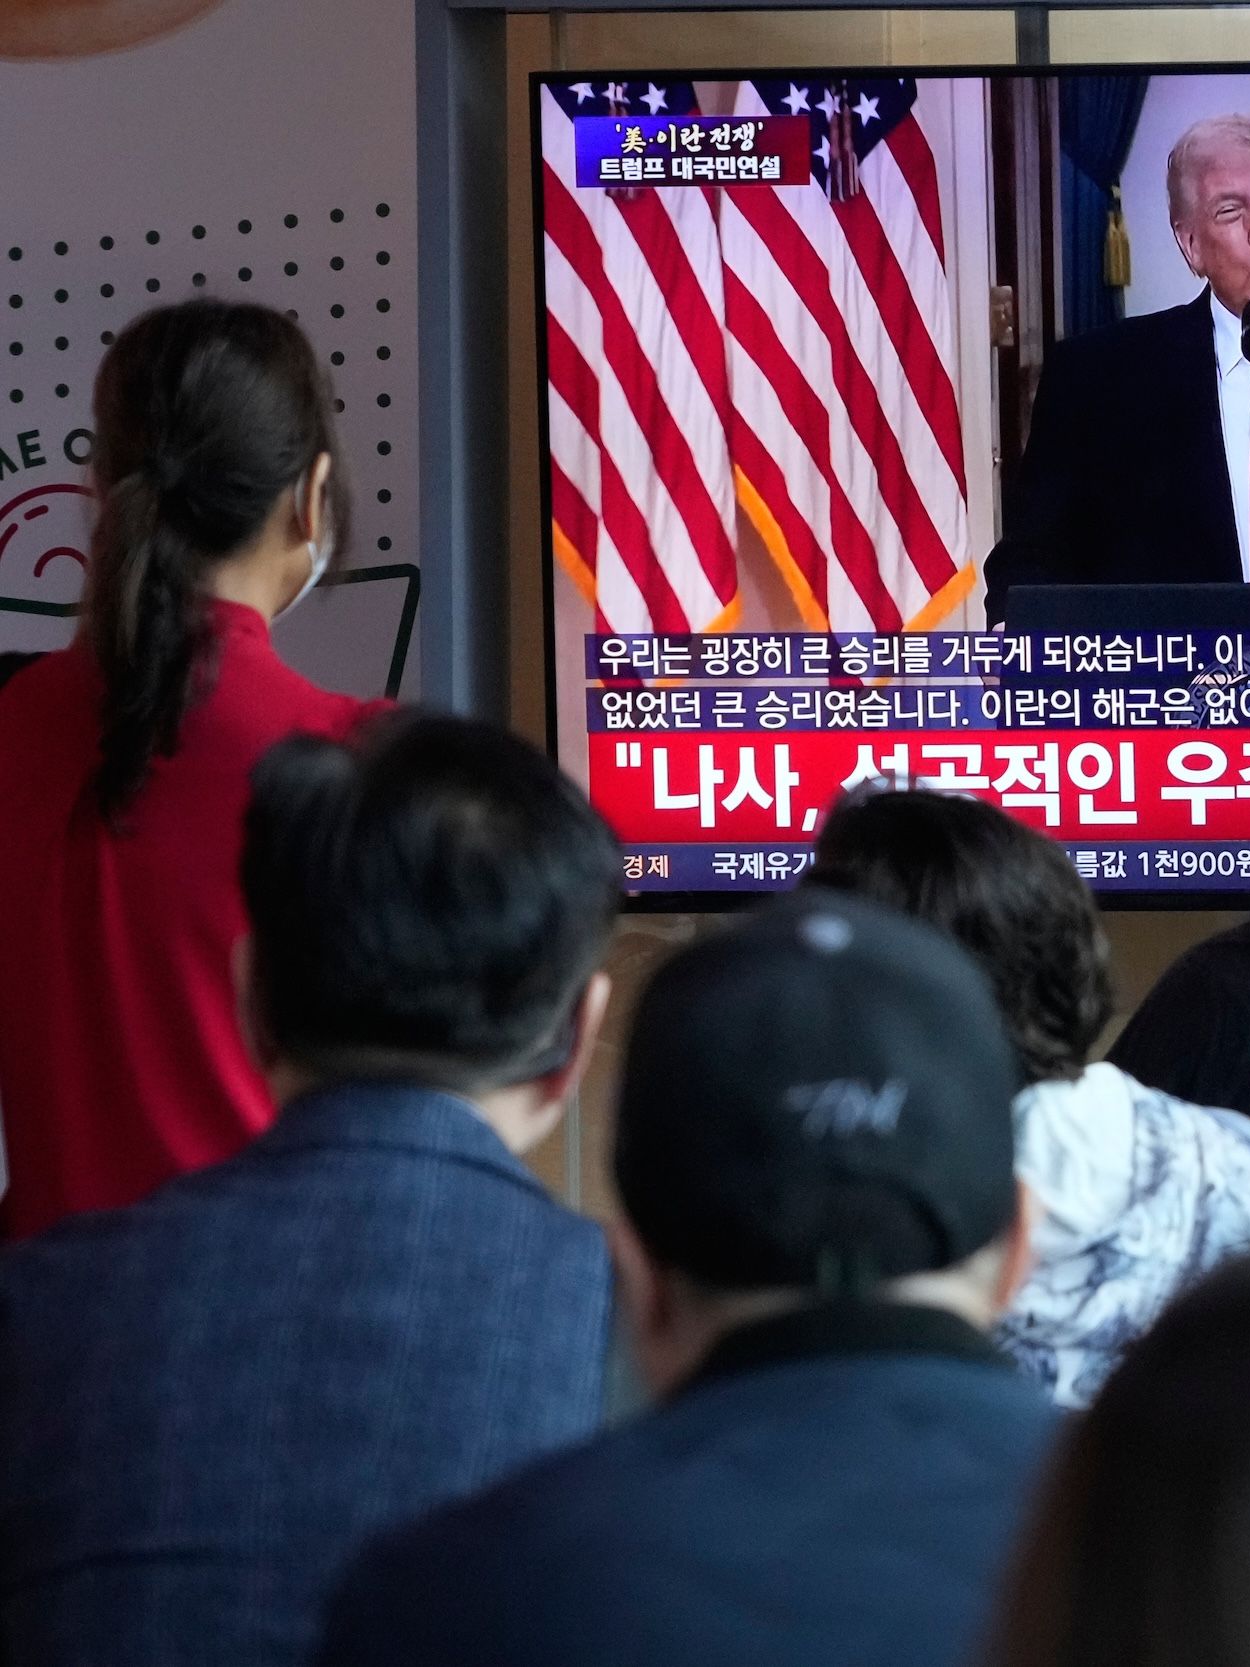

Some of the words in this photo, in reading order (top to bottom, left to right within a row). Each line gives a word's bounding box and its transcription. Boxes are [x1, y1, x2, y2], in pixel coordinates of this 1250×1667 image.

[599, 156, 666, 180] 트럼프
[671, 155, 781, 180] 대국민연설
[600, 637, 692, 675] 우리는
[700, 636, 792, 675] 굉장히
[800, 637, 832, 674] 큰
[839, 636, 932, 675] 승리를
[942, 635, 1031, 672] 거두게
[1043, 634, 1204, 672] 되었습니다.
[1215, 634, 1243, 672] 이
[602, 692, 701, 729] 없었던
[712, 692, 746, 728] 큰
[755, 690, 970, 729] 승리였습니다.
[981, 688, 1081, 727] 이란의
[1092, 688, 1195, 726] 해군은
[615, 742, 819, 832] "나사,
[623, 855, 670, 879] 경제
[1065, 849, 1128, 878] 름값
